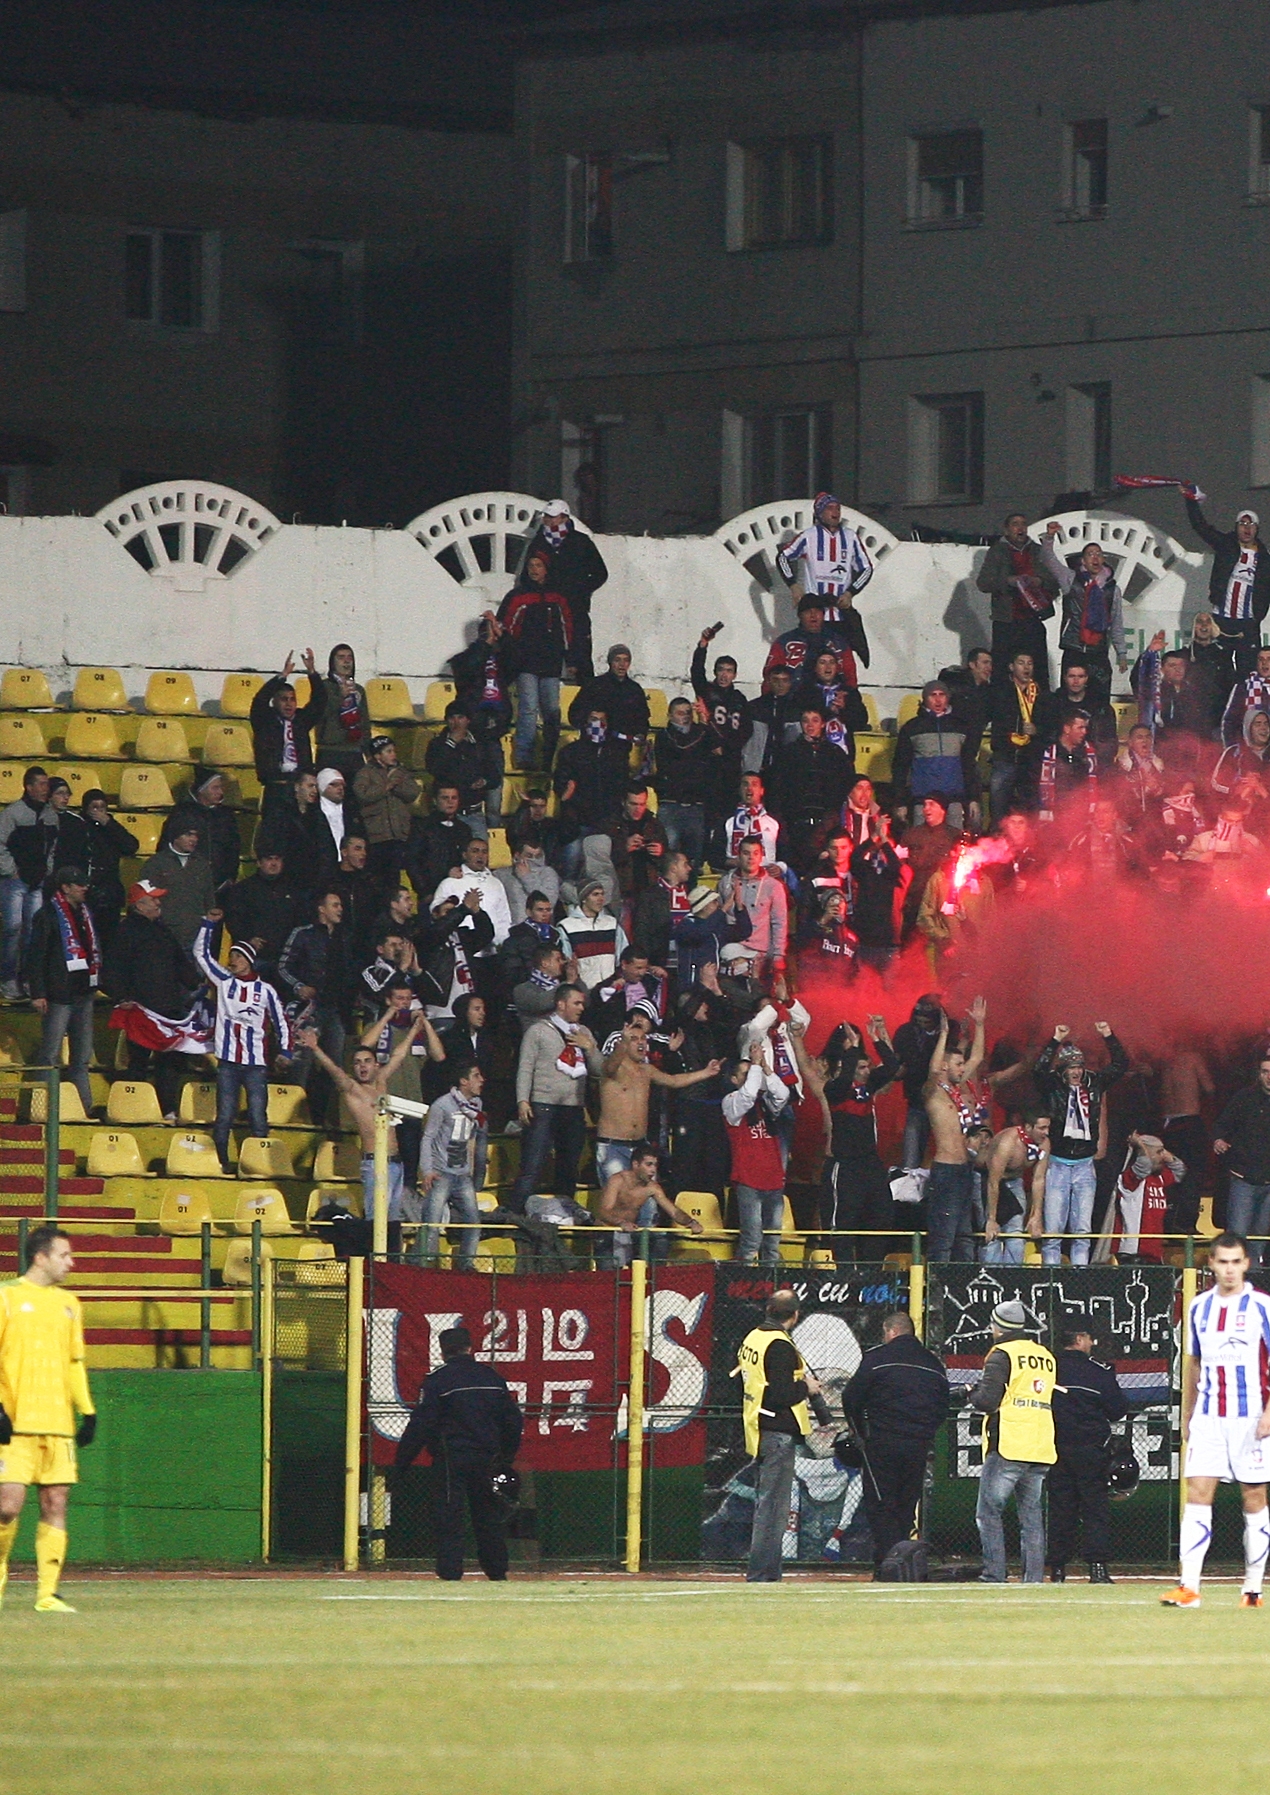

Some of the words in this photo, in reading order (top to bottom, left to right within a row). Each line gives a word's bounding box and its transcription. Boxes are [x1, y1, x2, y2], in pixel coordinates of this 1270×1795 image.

[125, 1085, 136, 1094] 02
[108, 1134, 119, 1143] 01
[178, 1206, 188, 1214] 01
[255, 1207, 266, 1216] 02
[726, 1280, 809, 1302] meru
[611, 1288, 710, 1439] S
[1017, 1355, 1054, 1373] FOTO
